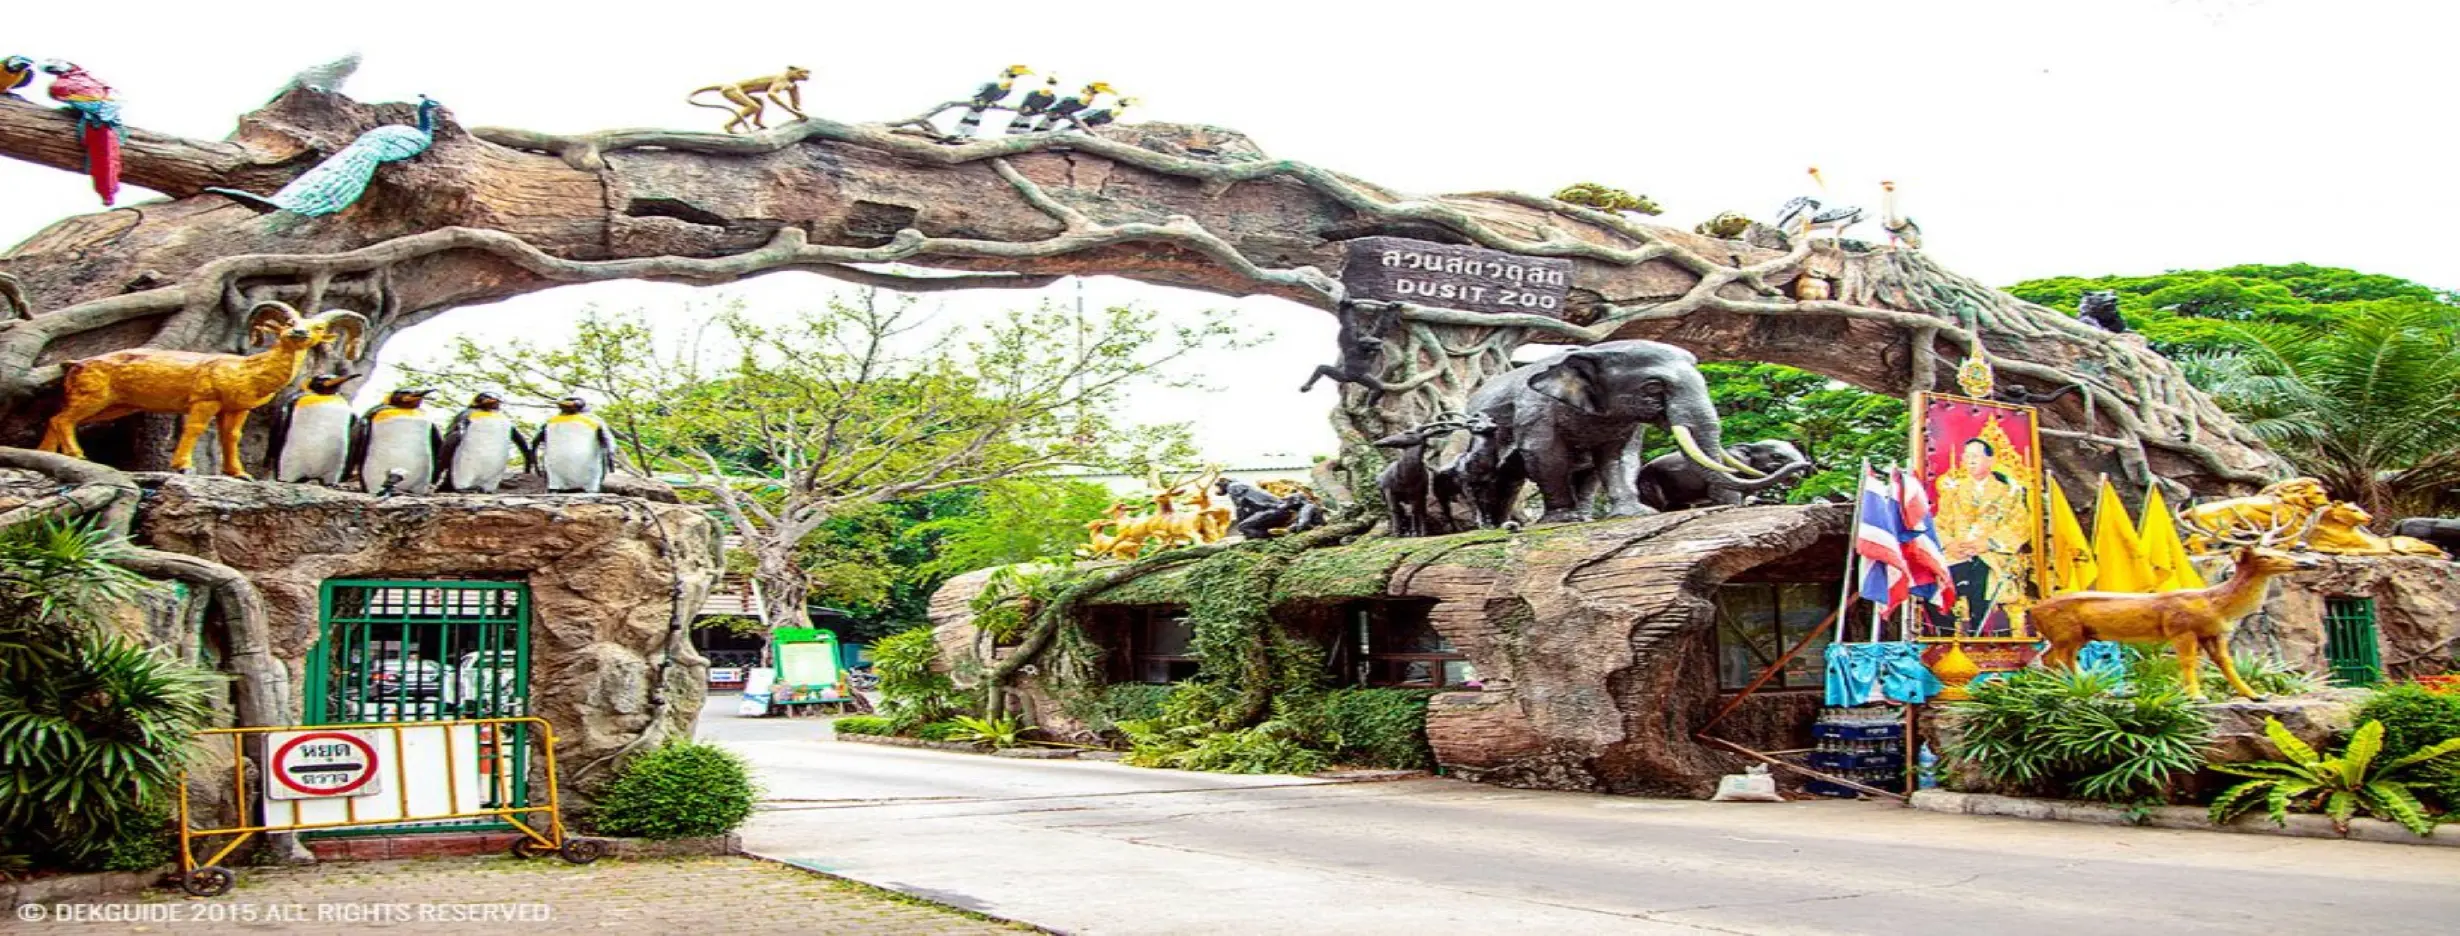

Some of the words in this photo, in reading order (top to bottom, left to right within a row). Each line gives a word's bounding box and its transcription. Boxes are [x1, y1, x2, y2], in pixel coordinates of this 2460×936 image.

[1397, 278, 1486, 302] DUSIT
[1499, 290, 1556, 309] ZOO
[300, 744, 351, 762] หยุด
[302, 773, 349, 784] ตรวจ
